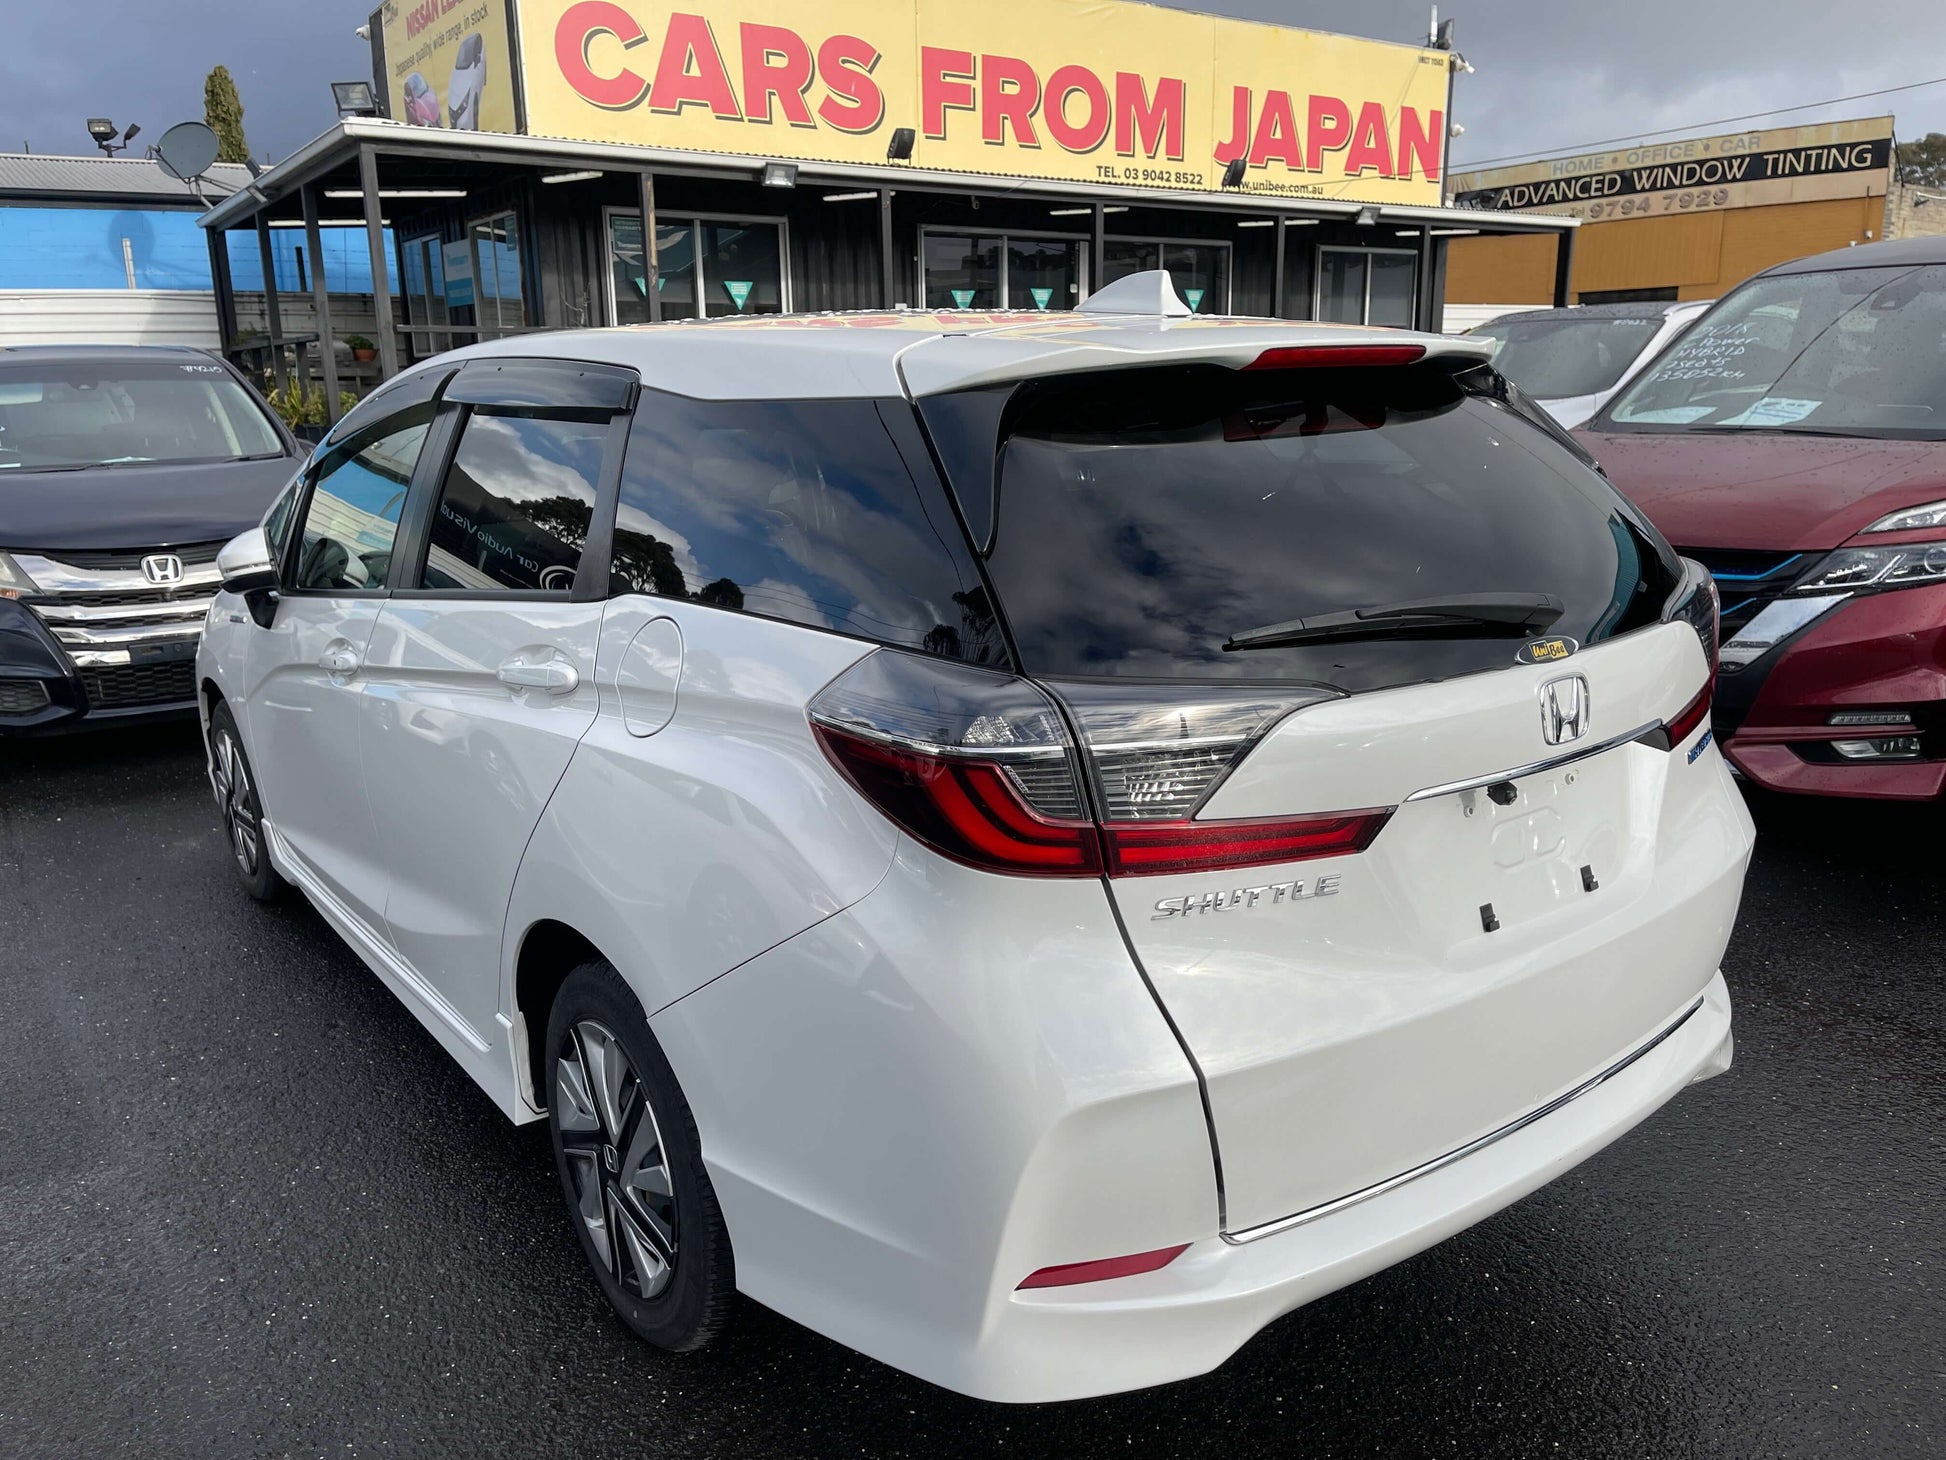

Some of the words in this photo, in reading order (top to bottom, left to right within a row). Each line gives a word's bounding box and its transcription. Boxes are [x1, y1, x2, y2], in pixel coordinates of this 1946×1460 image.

[433, 32, 446, 50] wide
[463, 14, 471, 31] in
[471, 2, 488, 26] stock
[554, 0, 886, 136] CARS
[921, 45, 1186, 162] FROM
[1213, 84, 1443, 182] JAPAN
[1096, 165, 1121, 179] TEL.
[1124, 167, 1138, 180] 03
[1142, 168, 1172, 183] 9042
[1175, 170, 1204, 185] 8522
[1497, 173, 1622, 209] ADVANCED
[1632, 156, 1750, 191] WINDOW
[1763, 143, 1873, 177] TINTING
[1553, 156, 1605, 176] HOME
[1626, 143, 1695, 165] OFFICE
[1719, 135, 1761, 154] CAR
[1590, 196, 1652, 219] 9794
[1663, 187, 1729, 210] 7929
[1150, 873, 1342, 921] SHUTTLE
